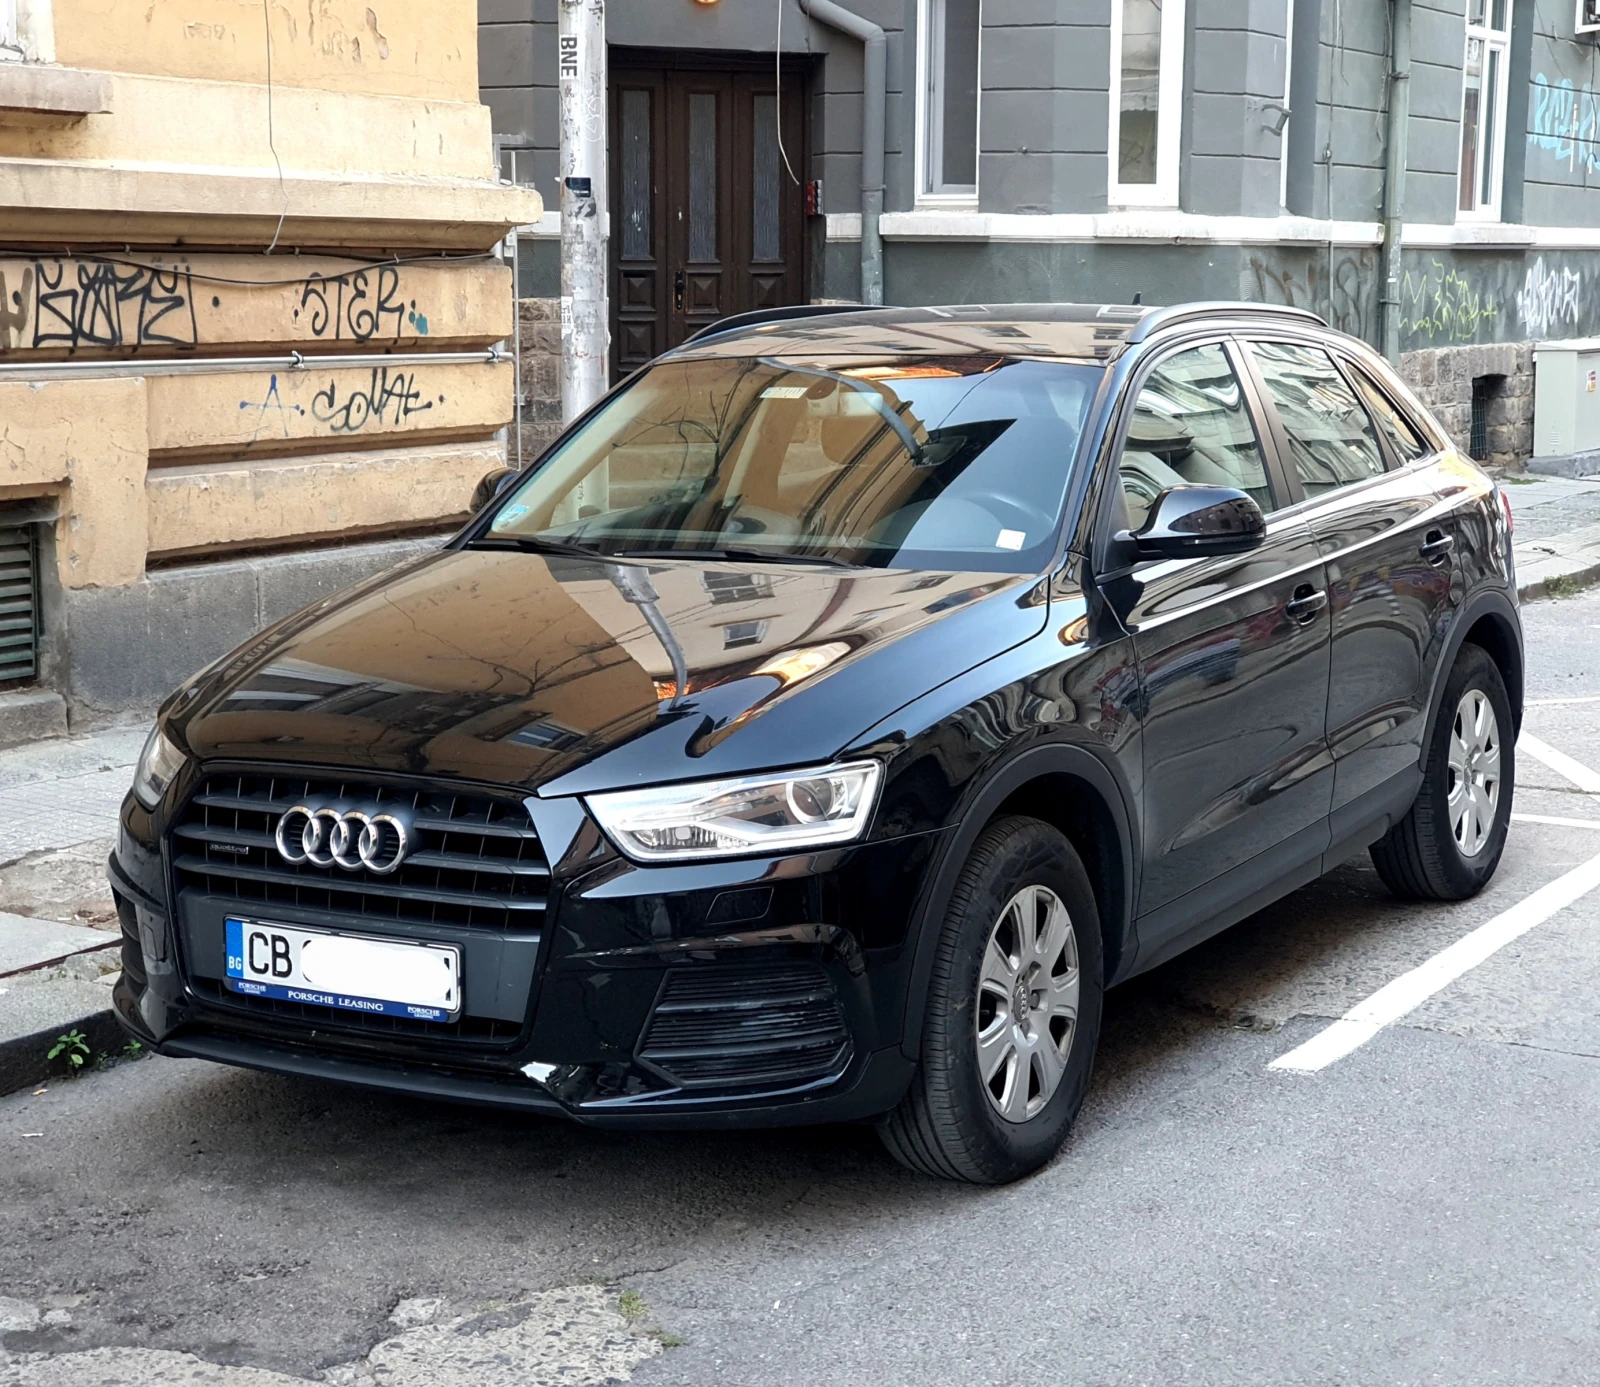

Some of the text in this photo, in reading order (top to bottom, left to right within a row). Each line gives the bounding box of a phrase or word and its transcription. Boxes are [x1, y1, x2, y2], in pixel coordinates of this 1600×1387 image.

[560, 36, 578, 77] BNE
[228, 956, 242, 970] BG
[248, 931, 293, 978] CB
[238, 982, 267, 992] PORSCHE
[287, 990, 384, 1011] PORSCHE LEASING
[407, 1006, 440, 1017] PORSCHE
